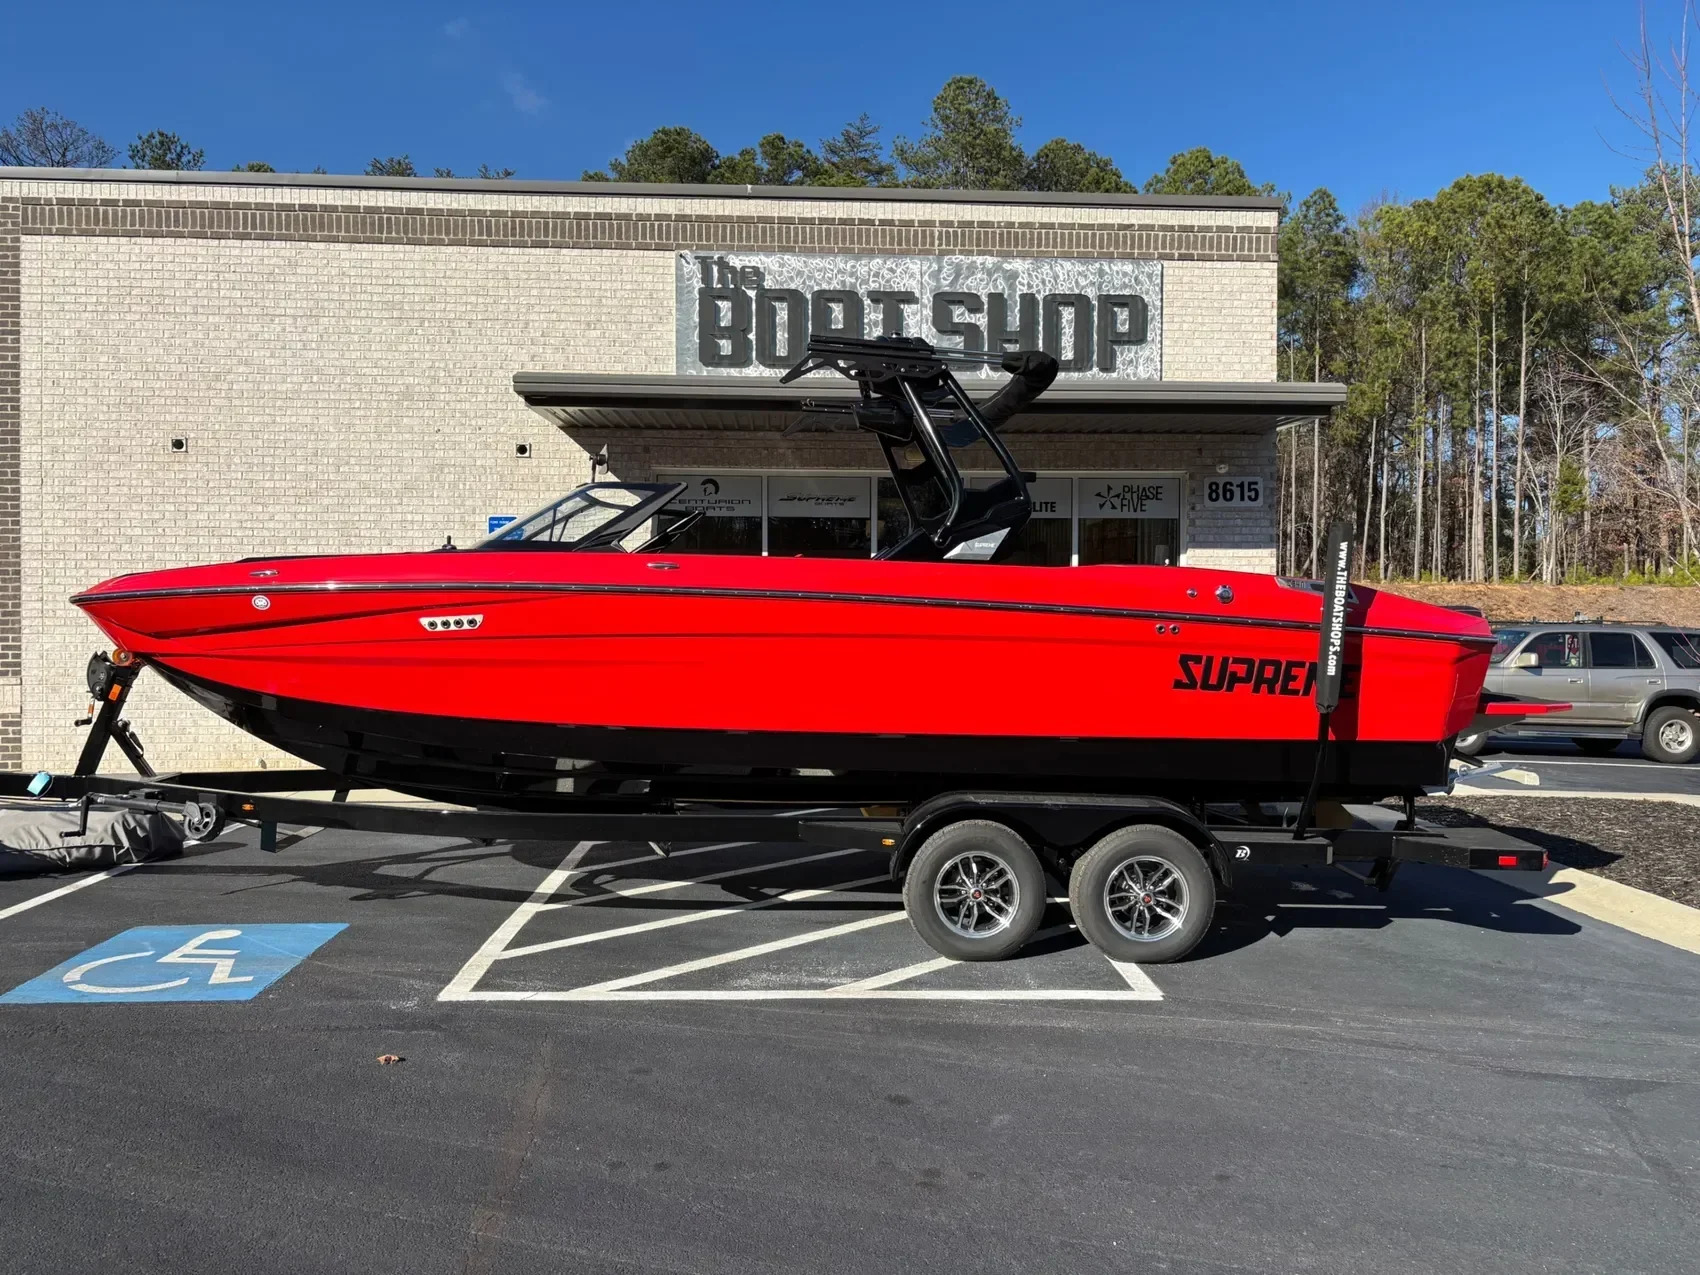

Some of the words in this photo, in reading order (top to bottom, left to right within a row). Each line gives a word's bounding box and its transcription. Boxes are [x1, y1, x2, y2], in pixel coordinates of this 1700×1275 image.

[695, 255, 766, 289] The
[698, 288, 919, 368] BOAT
[931, 291, 1148, 371] SHOP
[1122, 485, 1164, 501] PHASE
[1208, 480, 1260, 503] 8615
[684, 505, 736, 513] BOATS
[1120, 498, 1147, 513] FIVE
[1326, 541, 1348, 676] www.THEBOATSHOPS.com
